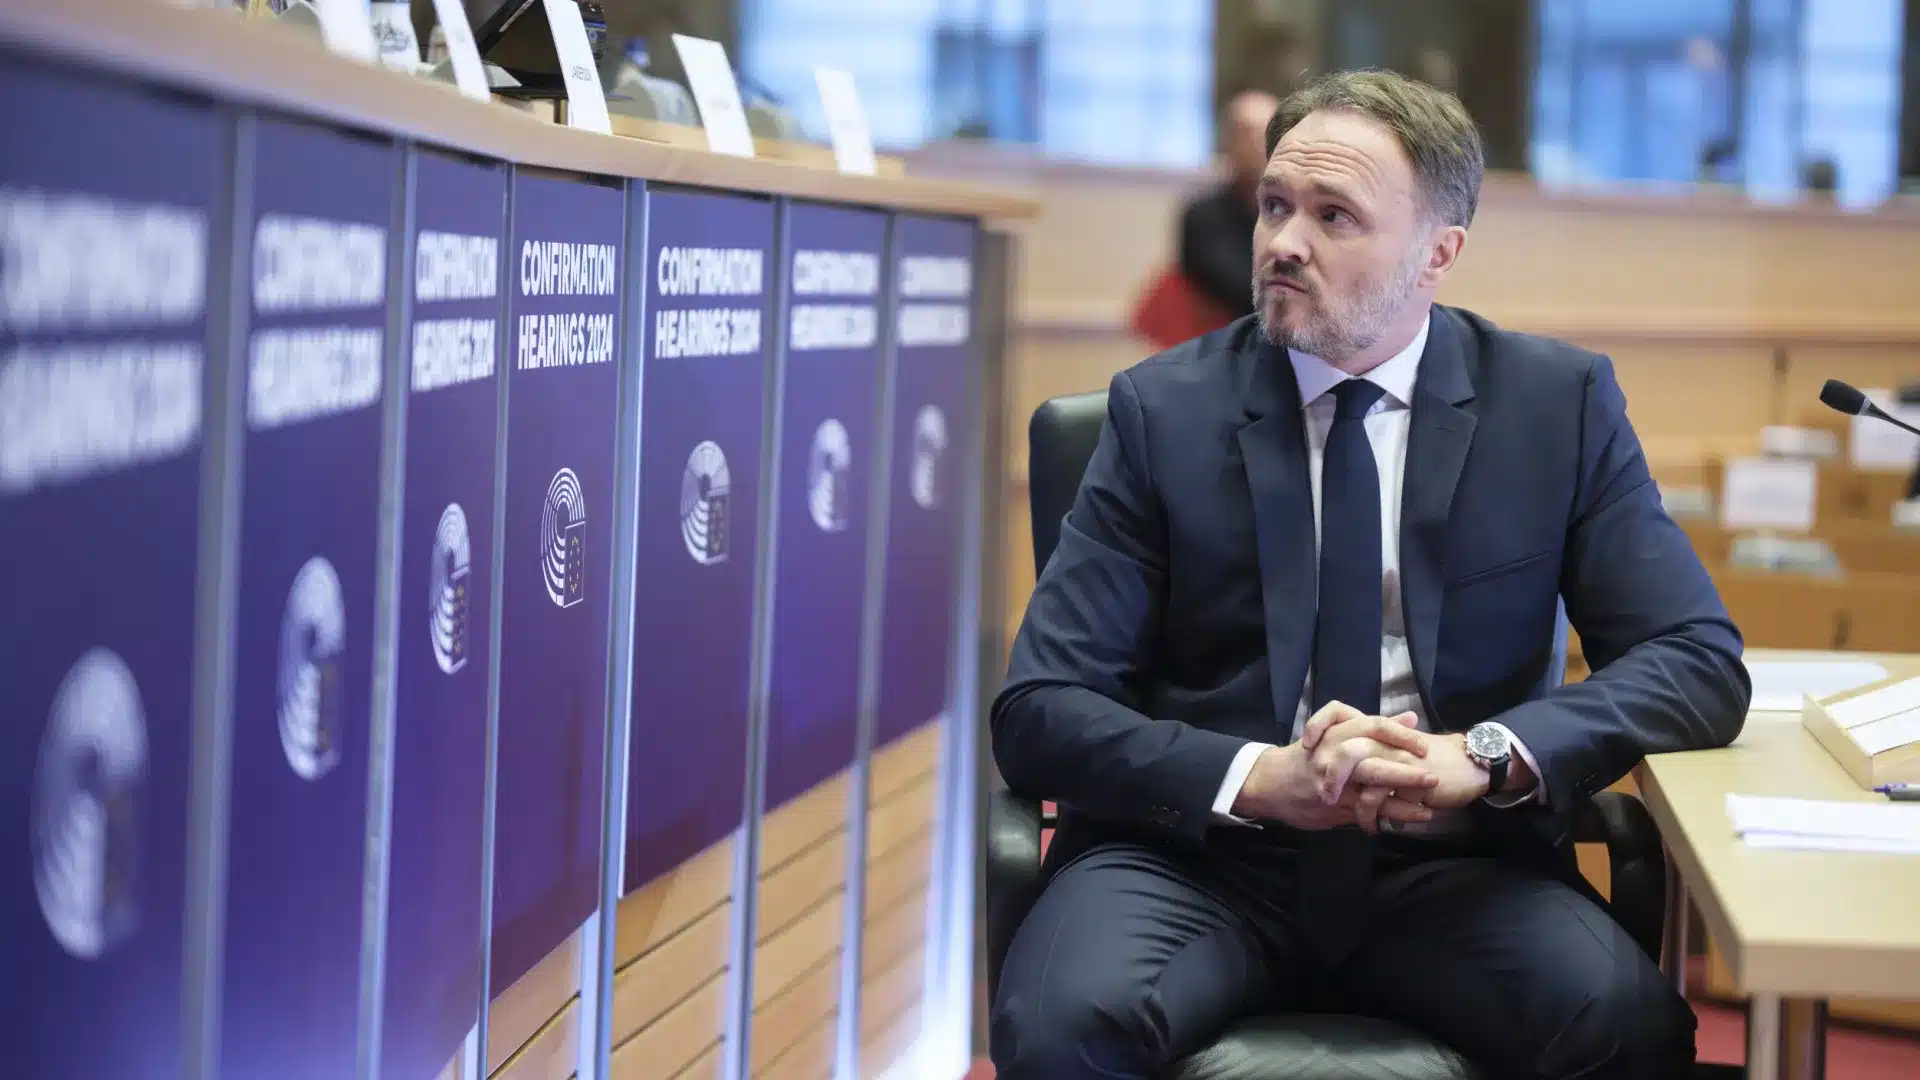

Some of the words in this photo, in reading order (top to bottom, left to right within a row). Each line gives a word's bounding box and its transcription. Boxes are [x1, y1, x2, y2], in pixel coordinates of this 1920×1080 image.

[520, 239, 616, 296] CONFIRMATION
[657, 246, 763, 296] CONFIRMATION
[518, 312, 586, 370] HEARINGS
[586, 313, 614, 363] 2024
